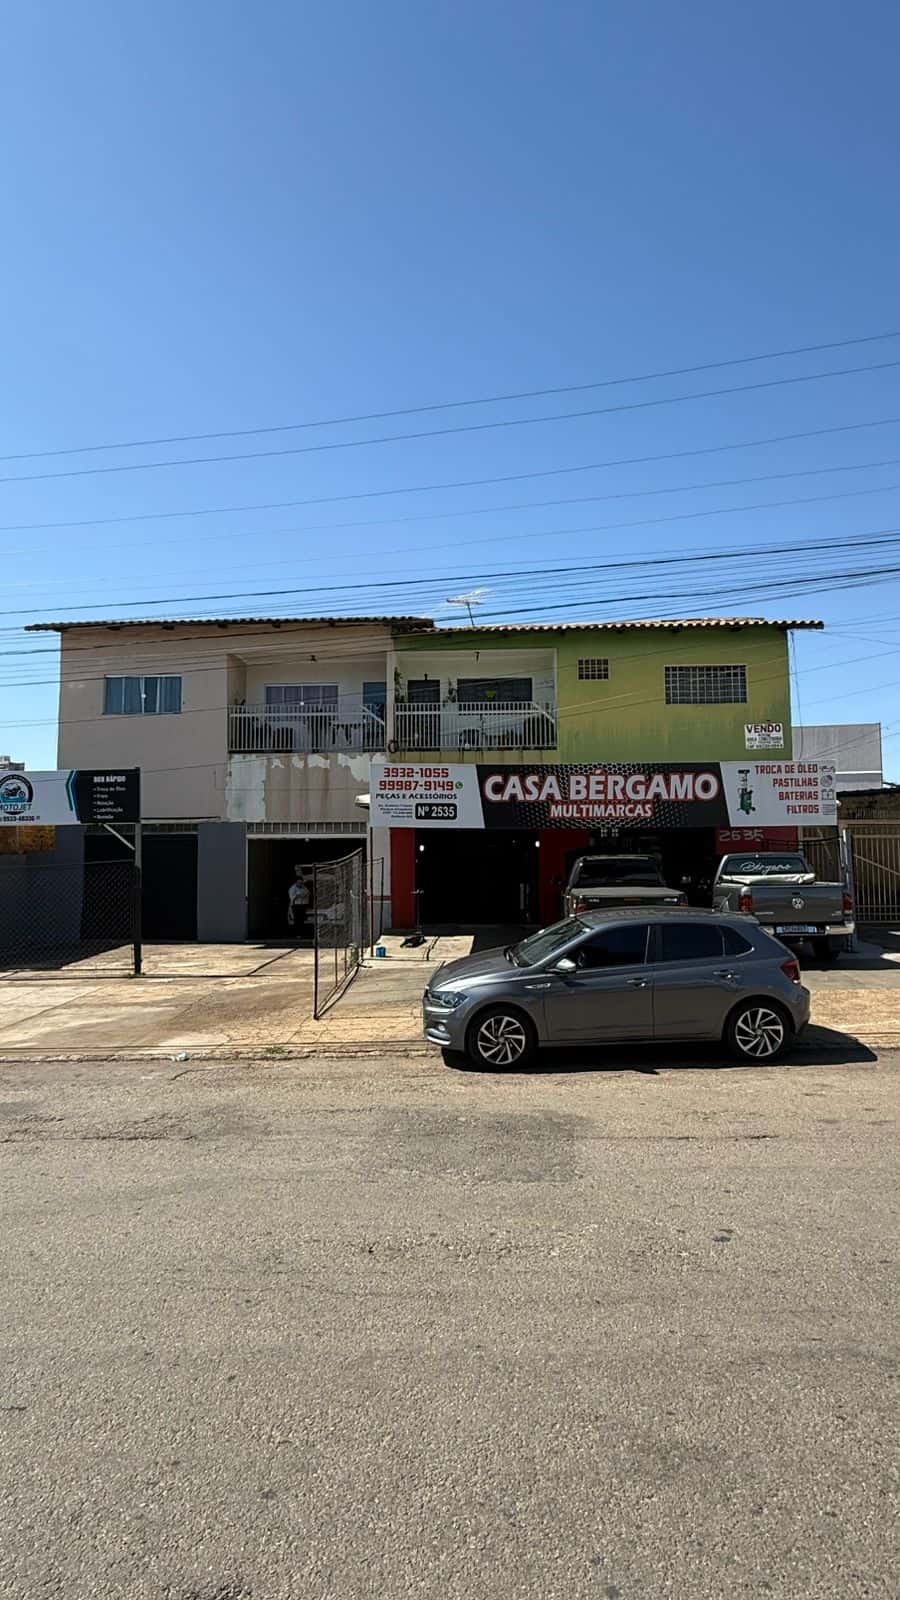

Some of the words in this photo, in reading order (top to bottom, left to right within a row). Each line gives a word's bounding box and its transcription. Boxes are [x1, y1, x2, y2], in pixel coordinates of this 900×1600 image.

[746, 724, 781, 734] VENDO
[384, 767, 449, 778] 3932-1055
[755, 765, 782, 774] TROCA
[784, 765, 795, 774] DE
[797, 763, 818, 774] ÓLEO
[106, 774, 126, 783] RÁPIDO
[772, 777, 818, 788] PASTILHAS
[379, 780, 454, 791] 99987-9149
[484, 774, 562, 801] CASA
[569, 768, 719, 801] BÉRGAMO
[409, 792, 457, 800] ACESSÓRIOS
[778, 791, 819, 801] BATERIAS
[431, 806, 455, 817] 2535
[550, 804, 652, 818] MULTIMARCAS
[786, 804, 819, 814] FILTROS
[719, 829, 764, 842] 2635
